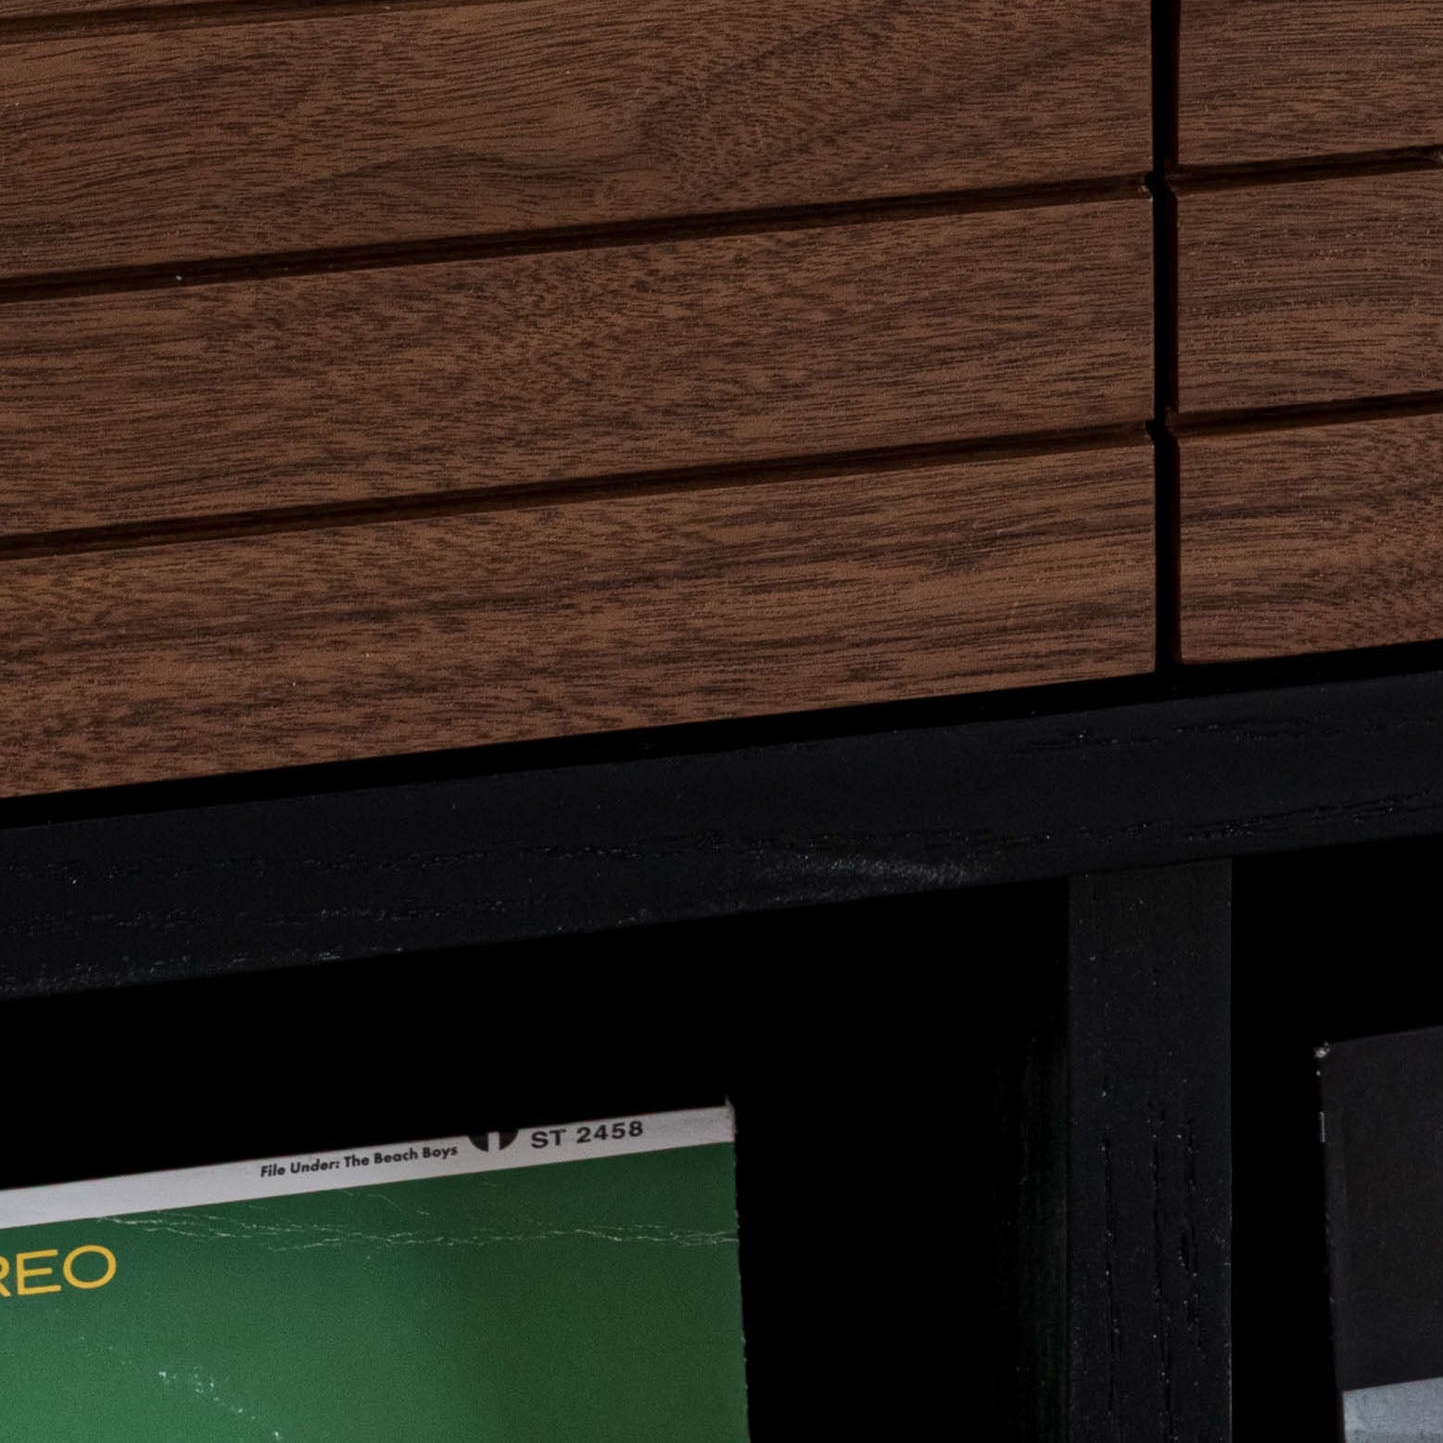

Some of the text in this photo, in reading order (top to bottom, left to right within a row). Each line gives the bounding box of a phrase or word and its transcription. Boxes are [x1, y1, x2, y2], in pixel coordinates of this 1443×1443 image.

[531, 1121, 644, 1149] ST 2458
[260, 1144, 459, 1178] File Under: The Beach Boys
